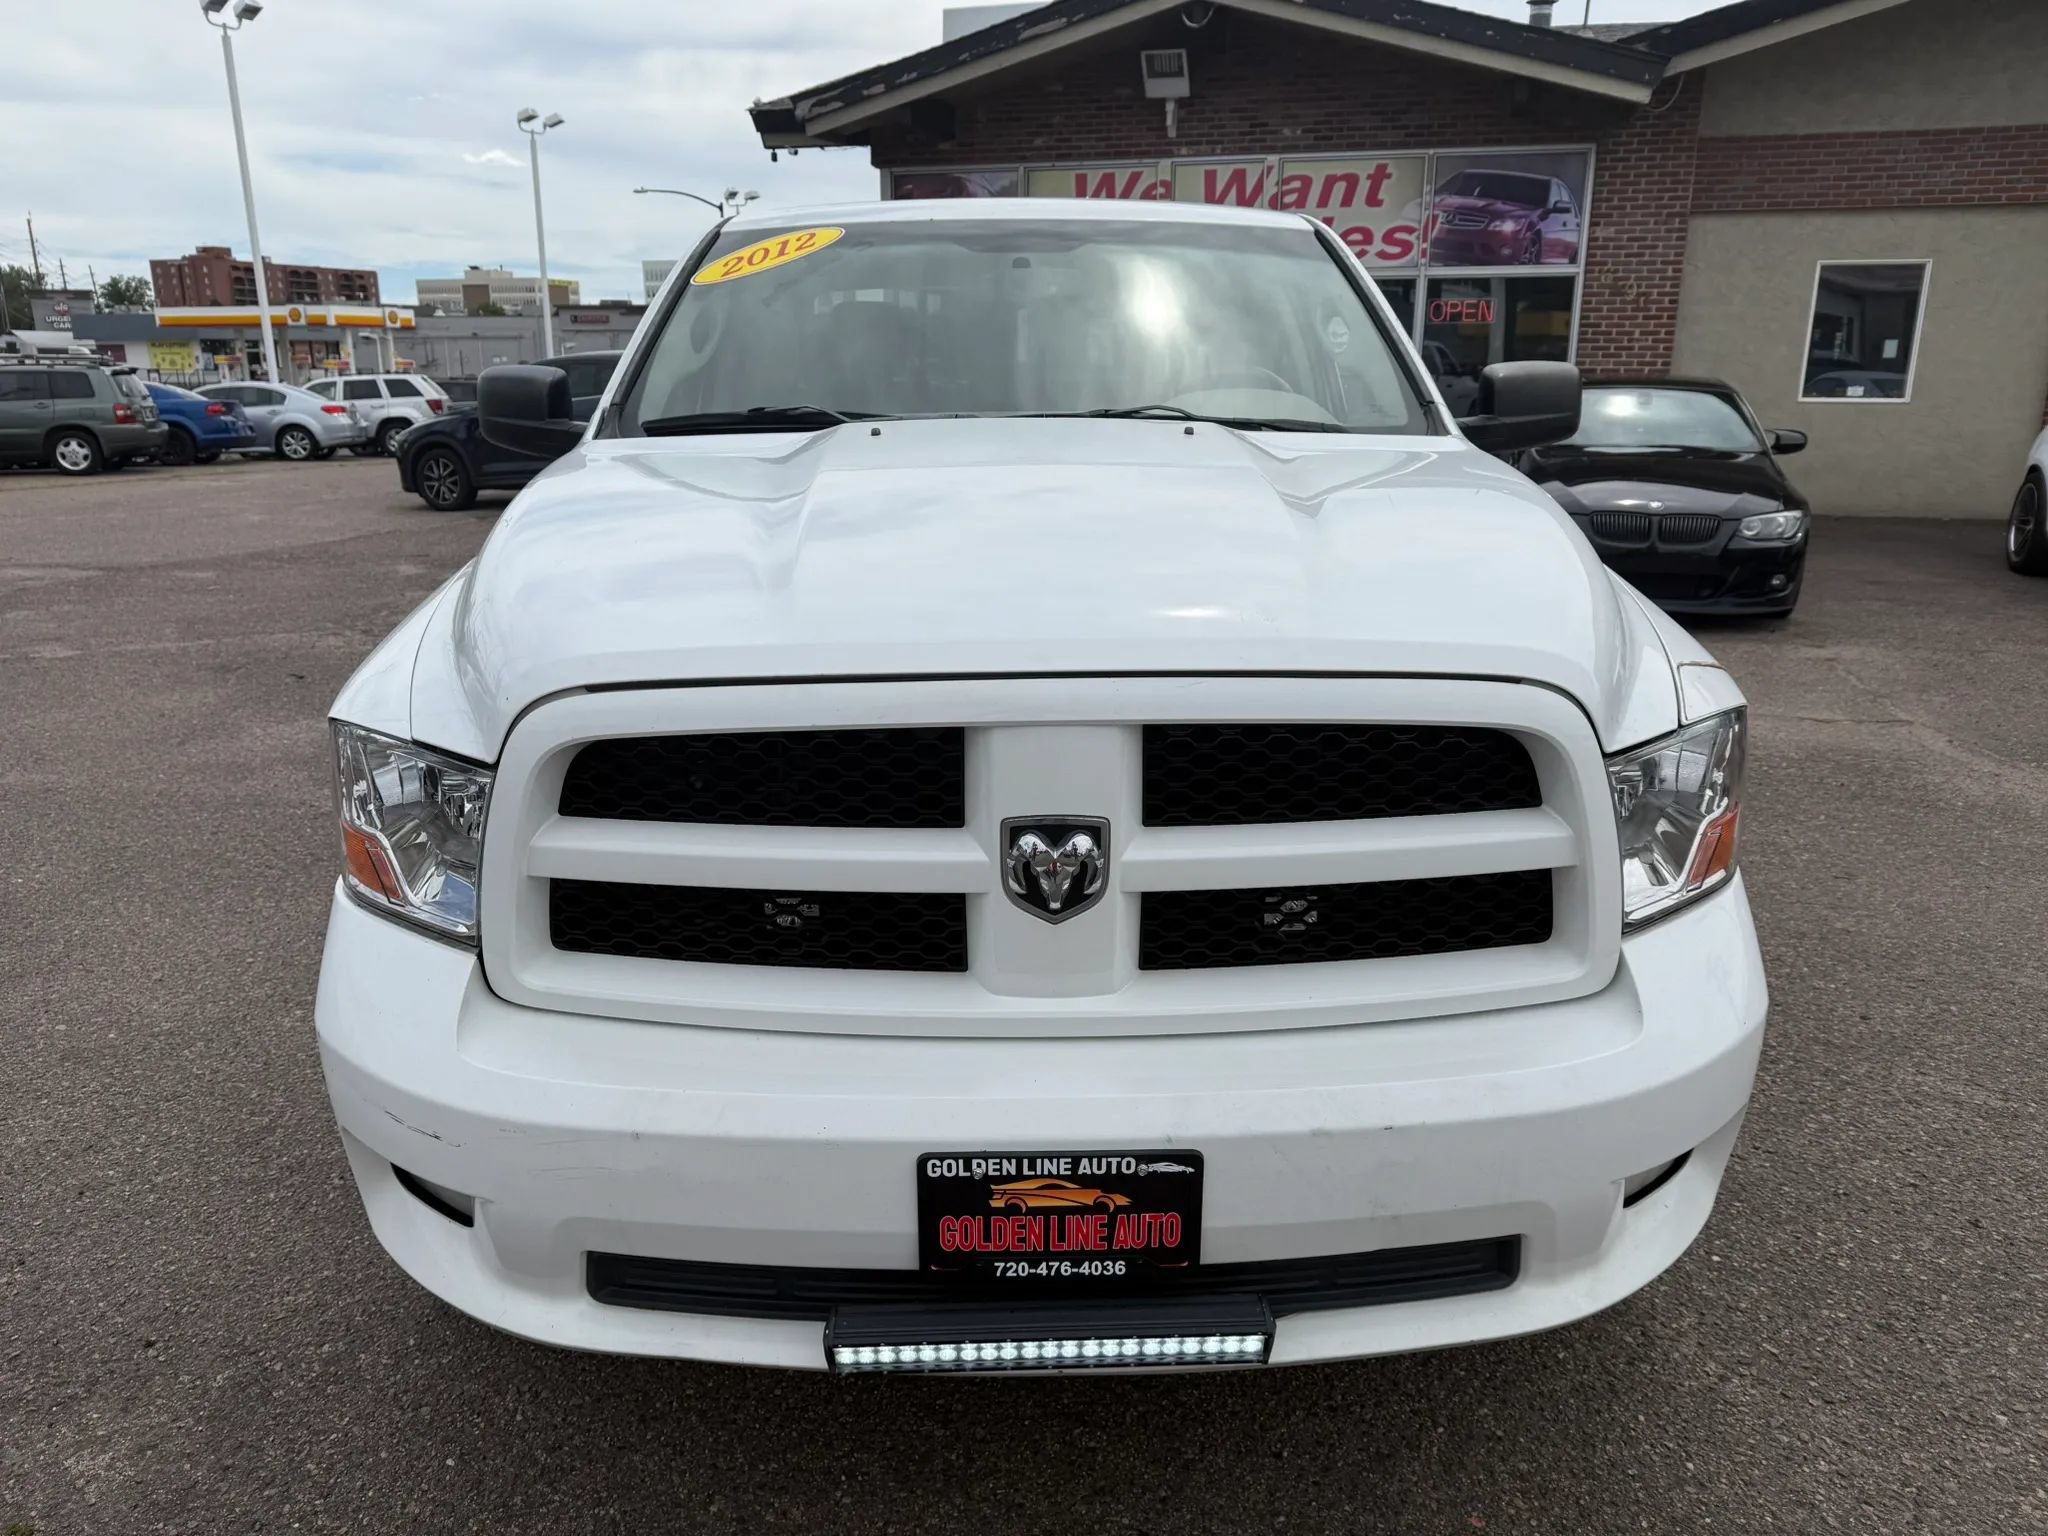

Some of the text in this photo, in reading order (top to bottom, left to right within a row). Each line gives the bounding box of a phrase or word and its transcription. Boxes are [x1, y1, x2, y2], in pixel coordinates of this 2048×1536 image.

[1075, 162, 1391, 211] We Want
[720, 232, 817, 278] 2012
[1430, 300, 1494, 322] OPEN
[926, 1157, 1137, 1178] GOLDEN LINE AUTO
[939, 1212, 1182, 1252] GOLDEN LINE AUTO
[994, 1261, 1127, 1277] 720-476-4036
